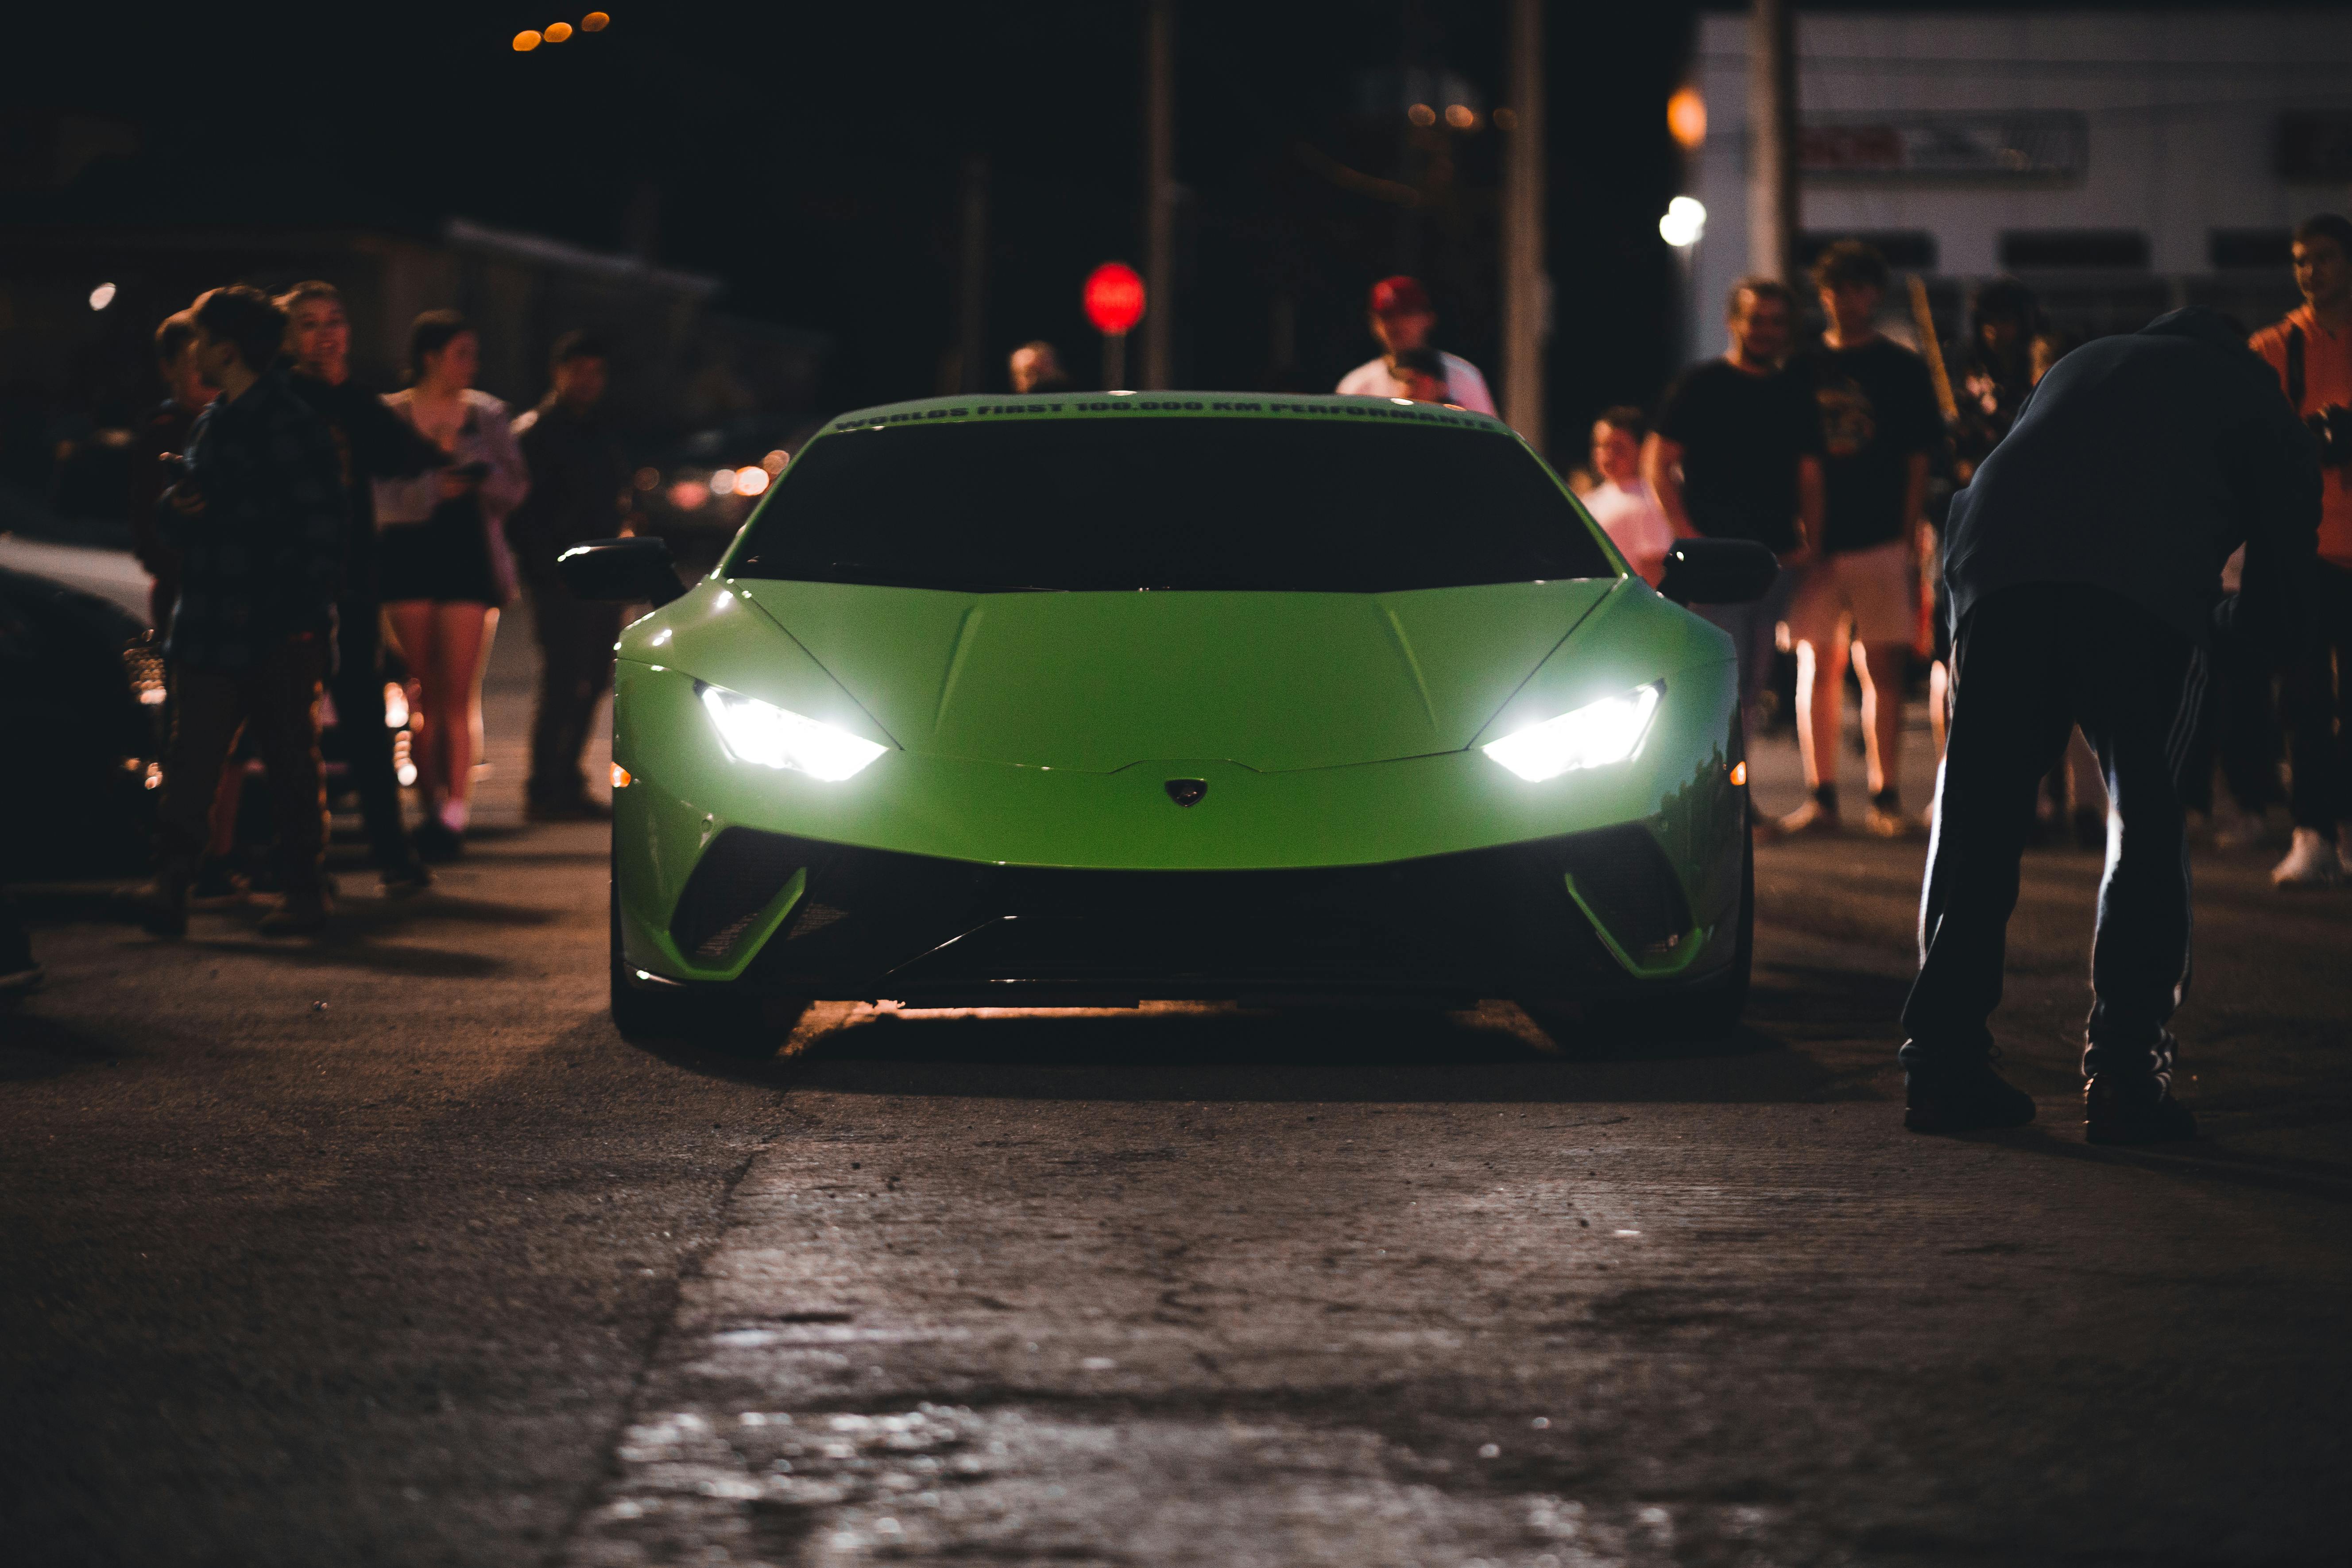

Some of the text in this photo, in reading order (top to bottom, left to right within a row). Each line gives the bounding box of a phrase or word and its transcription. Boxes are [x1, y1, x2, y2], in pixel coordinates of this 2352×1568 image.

[835, 408, 968, 429] WORLDS
[977, 404, 1062, 414] FIRST
[1213, 403, 1261, 411] KM
